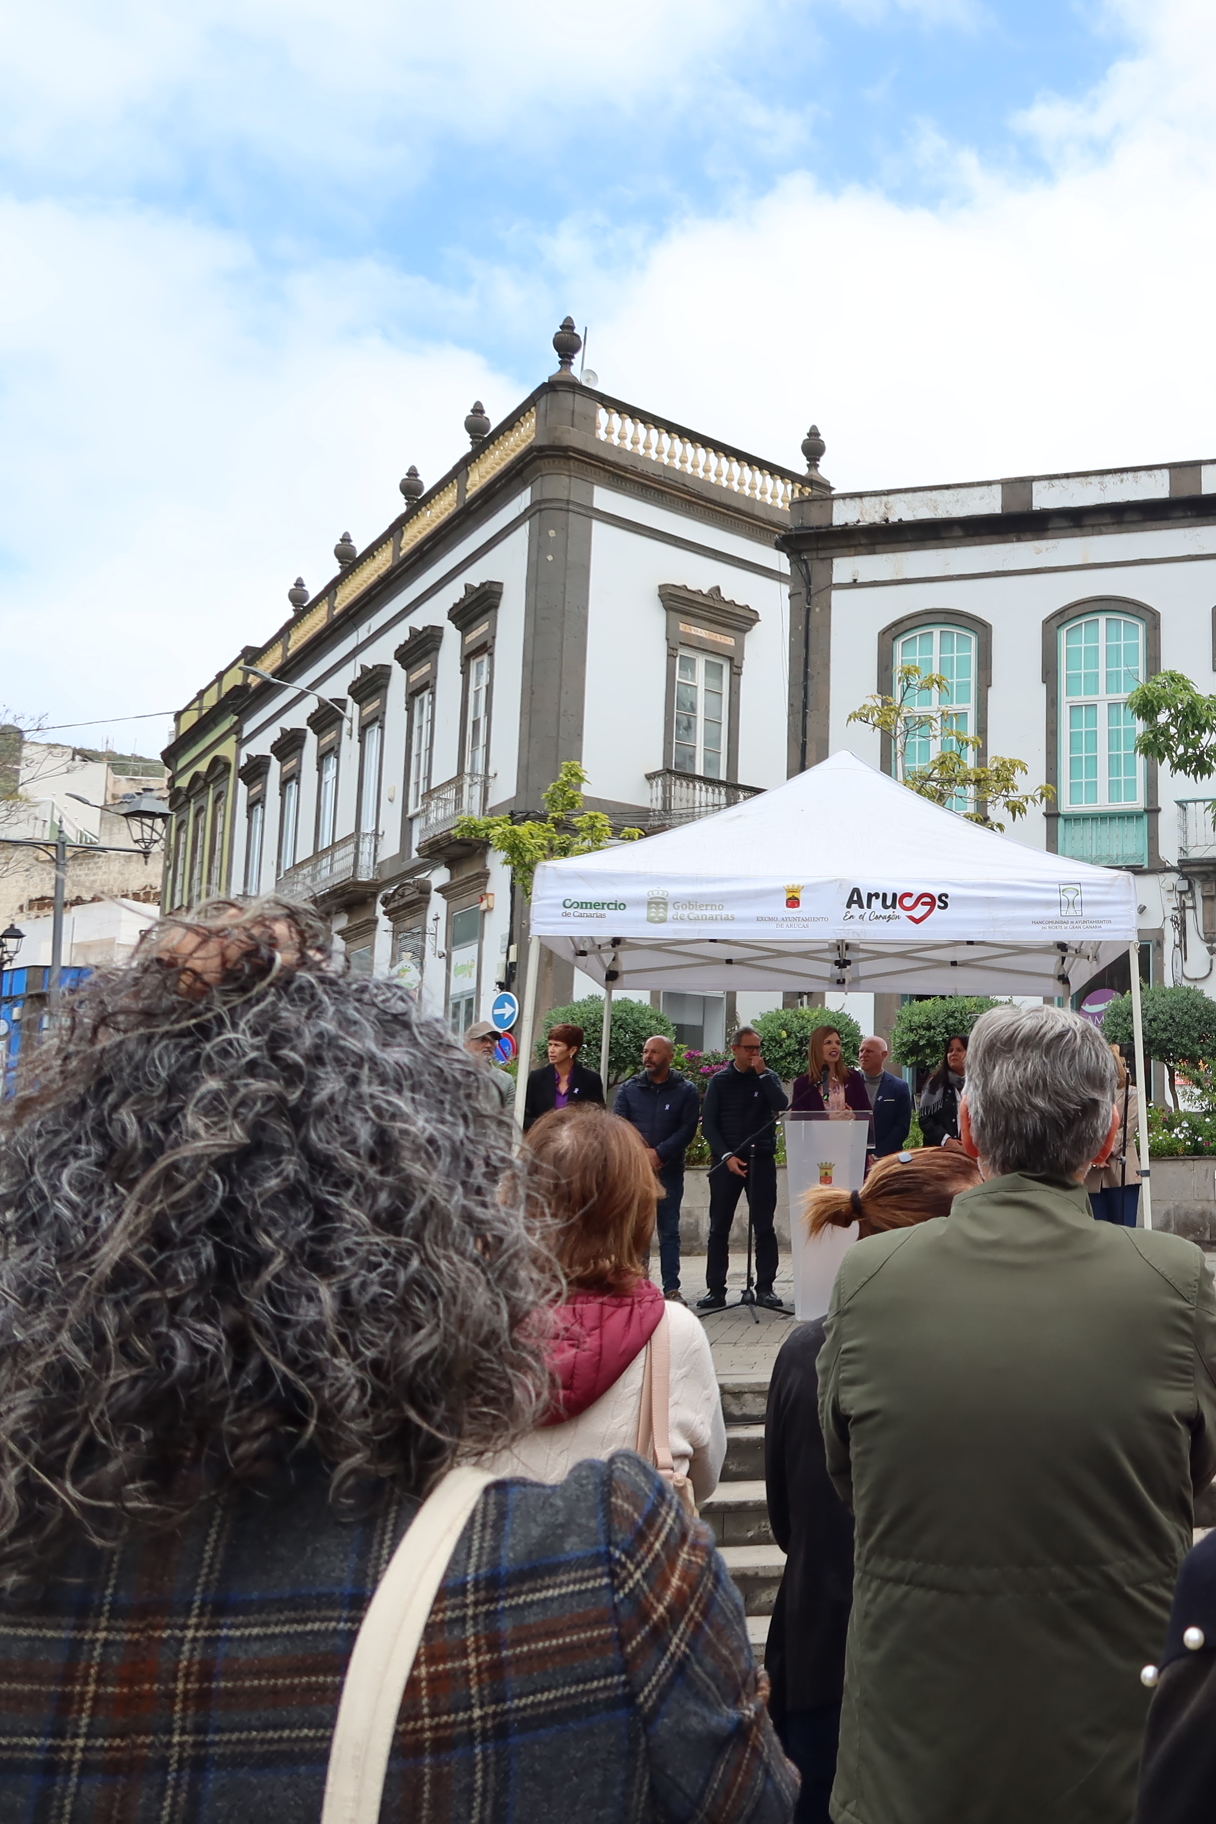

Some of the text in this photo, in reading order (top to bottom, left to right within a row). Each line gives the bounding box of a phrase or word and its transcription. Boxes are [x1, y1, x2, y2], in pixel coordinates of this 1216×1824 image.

[562, 898, 627, 911] Comercio
[672, 901, 724, 911] Gobierno
[845, 887, 949, 925] Arucas
[561, 910, 607, 919] de Canarias
[672, 911, 736, 921] de Canarias
[842, 910, 902, 923] En el Corazón
